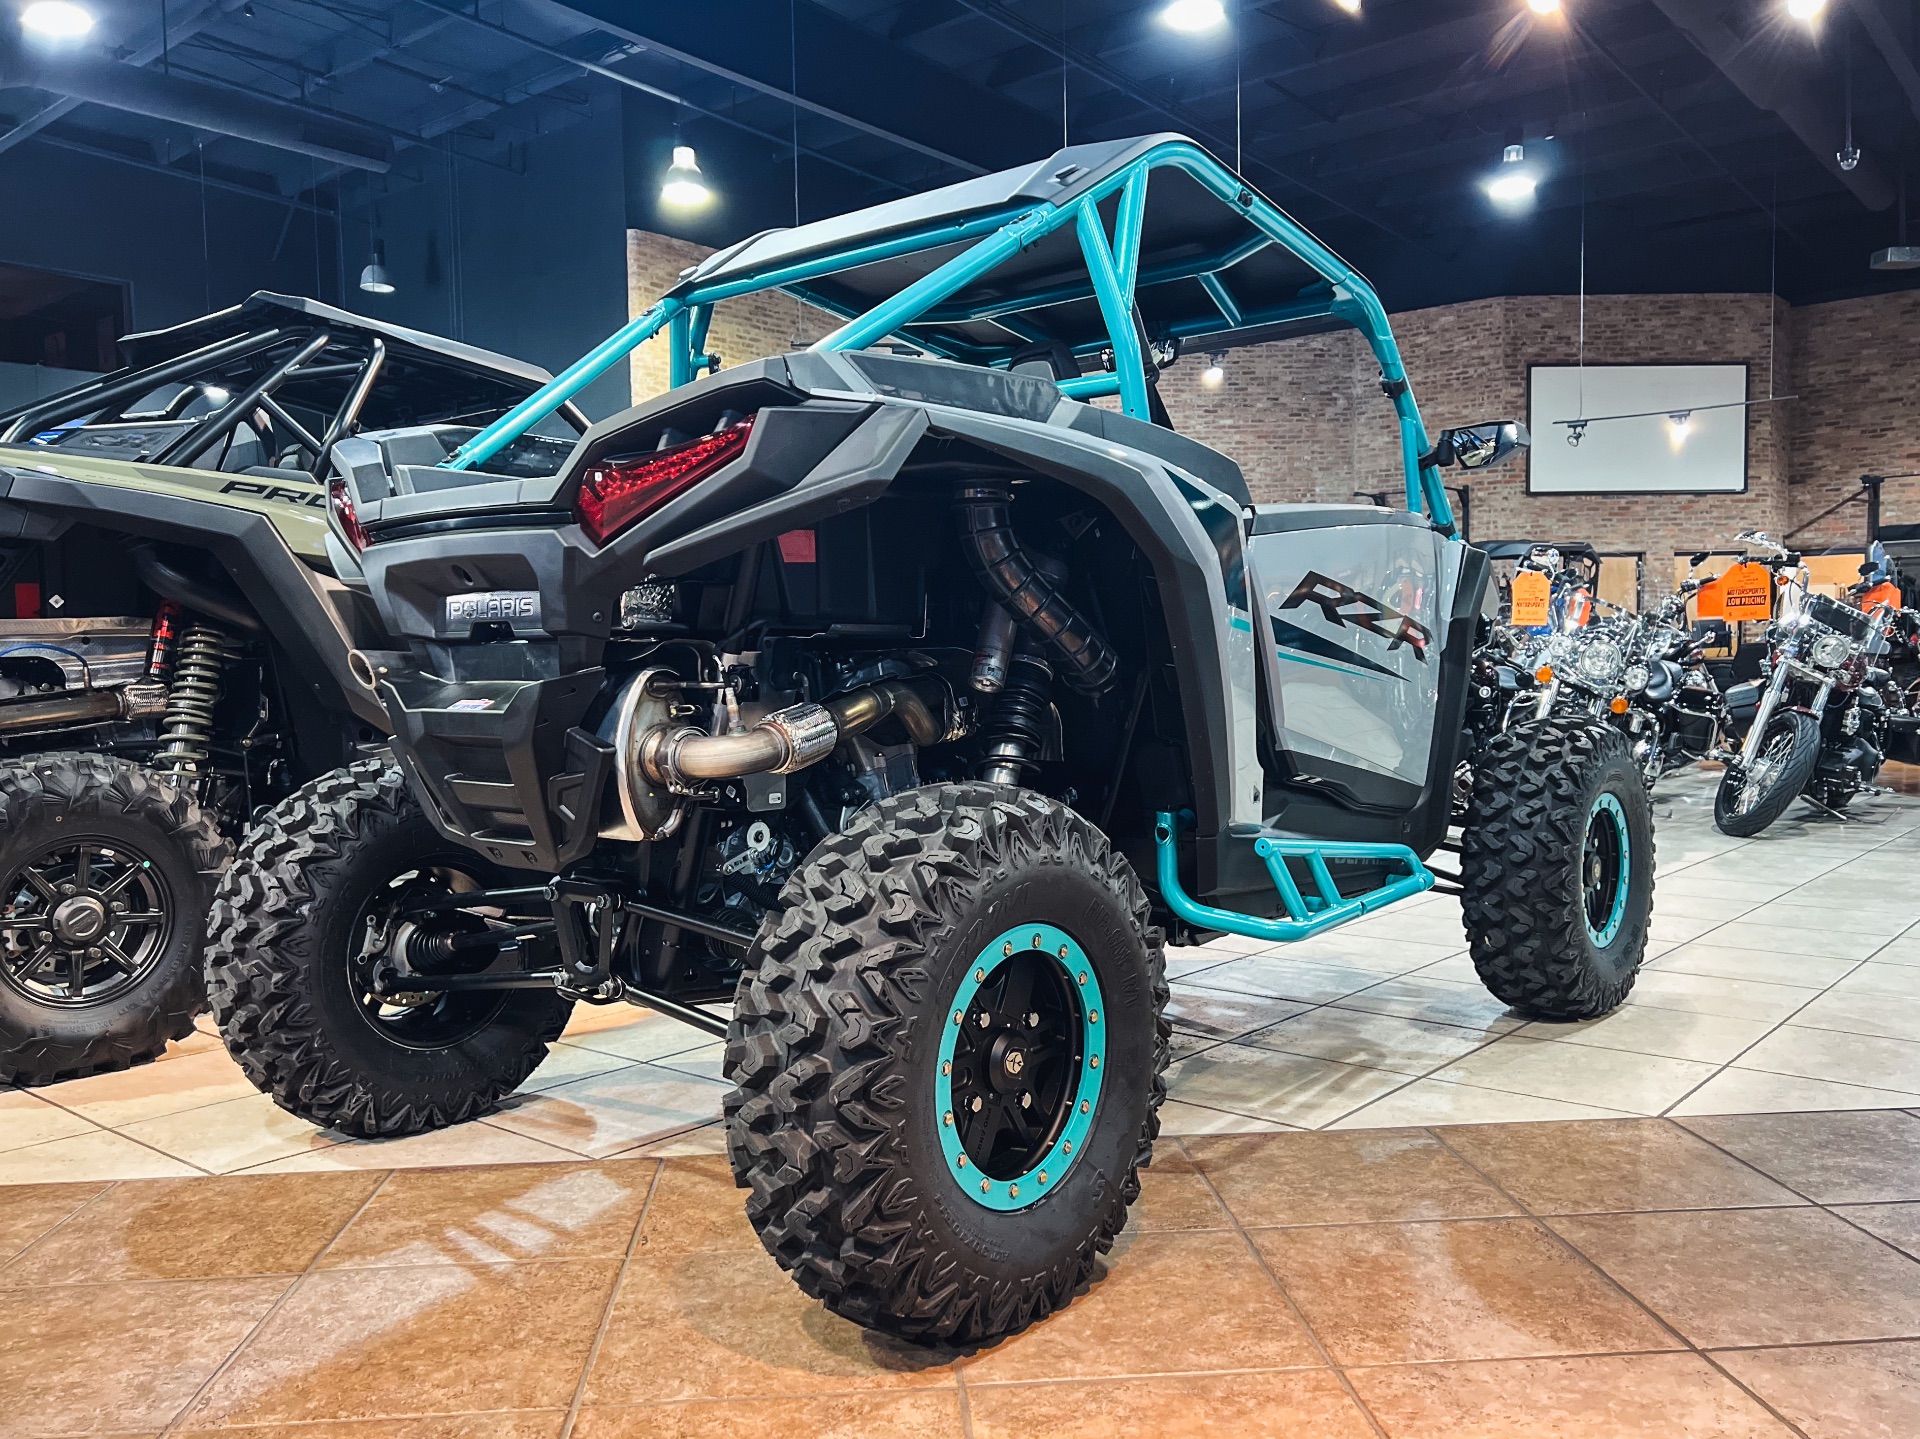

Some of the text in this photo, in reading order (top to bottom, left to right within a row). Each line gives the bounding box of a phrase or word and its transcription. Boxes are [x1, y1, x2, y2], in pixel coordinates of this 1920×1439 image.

[1727, 588, 1766, 596] MOTORSPORTS
[449, 597, 534, 619] POLARIS
[1728, 598, 1741, 606] LOW
[1279, 570, 1434, 665] RZR
